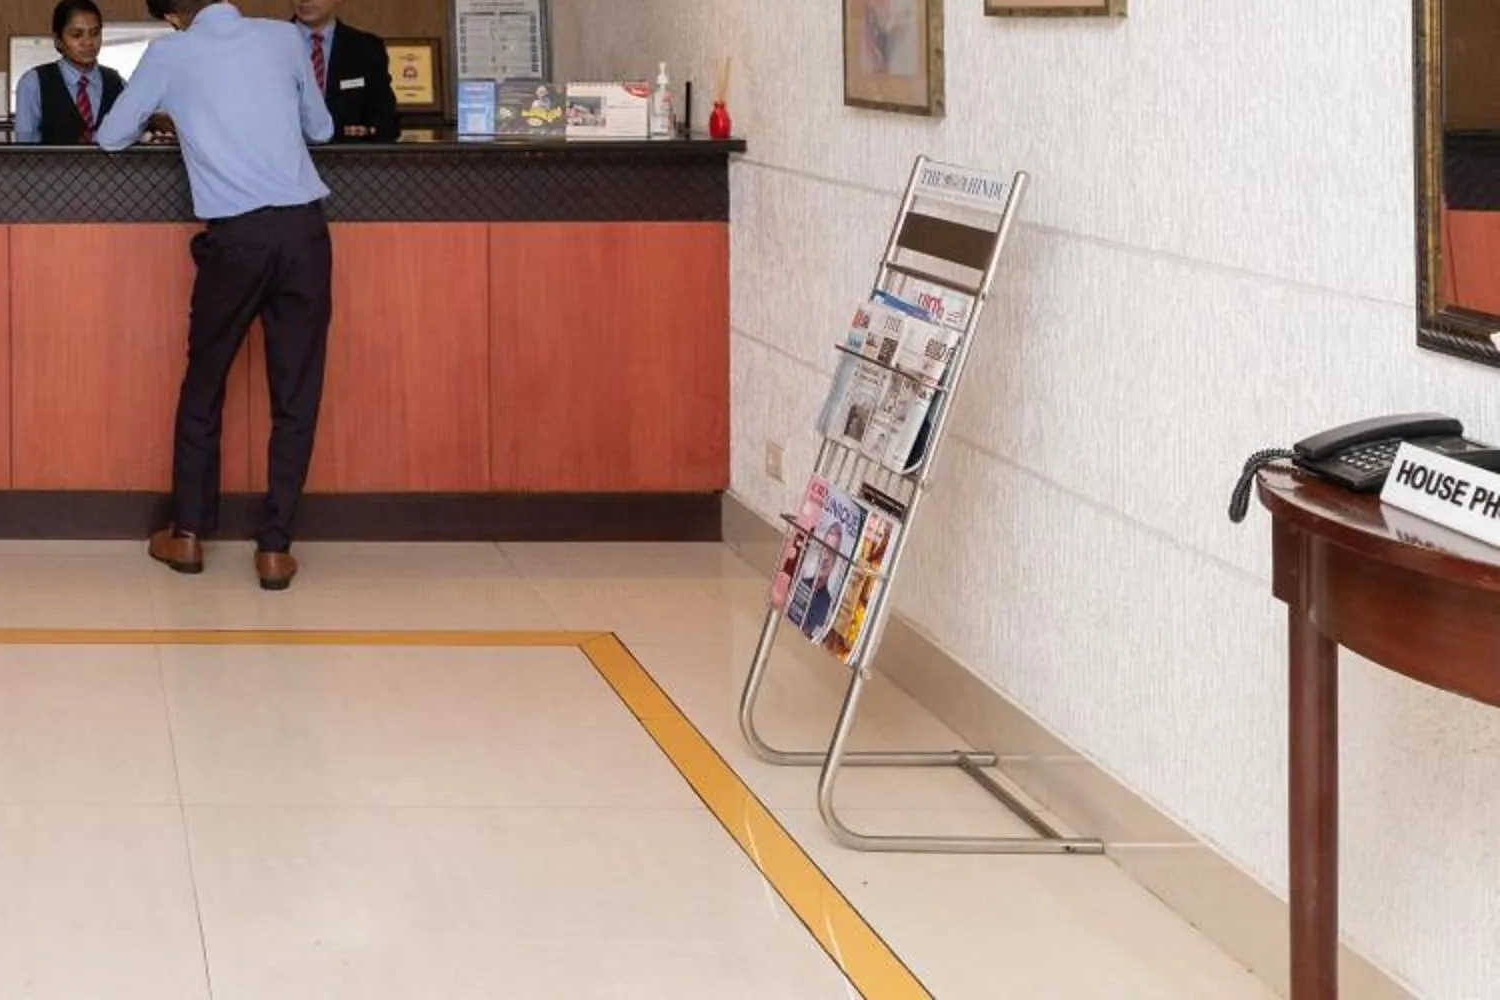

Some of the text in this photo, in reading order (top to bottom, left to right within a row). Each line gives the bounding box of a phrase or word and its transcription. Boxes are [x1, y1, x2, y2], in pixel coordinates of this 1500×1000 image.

[921, 168, 942, 187] THE
[1396, 459, 1500, 519] HOUSE PH
